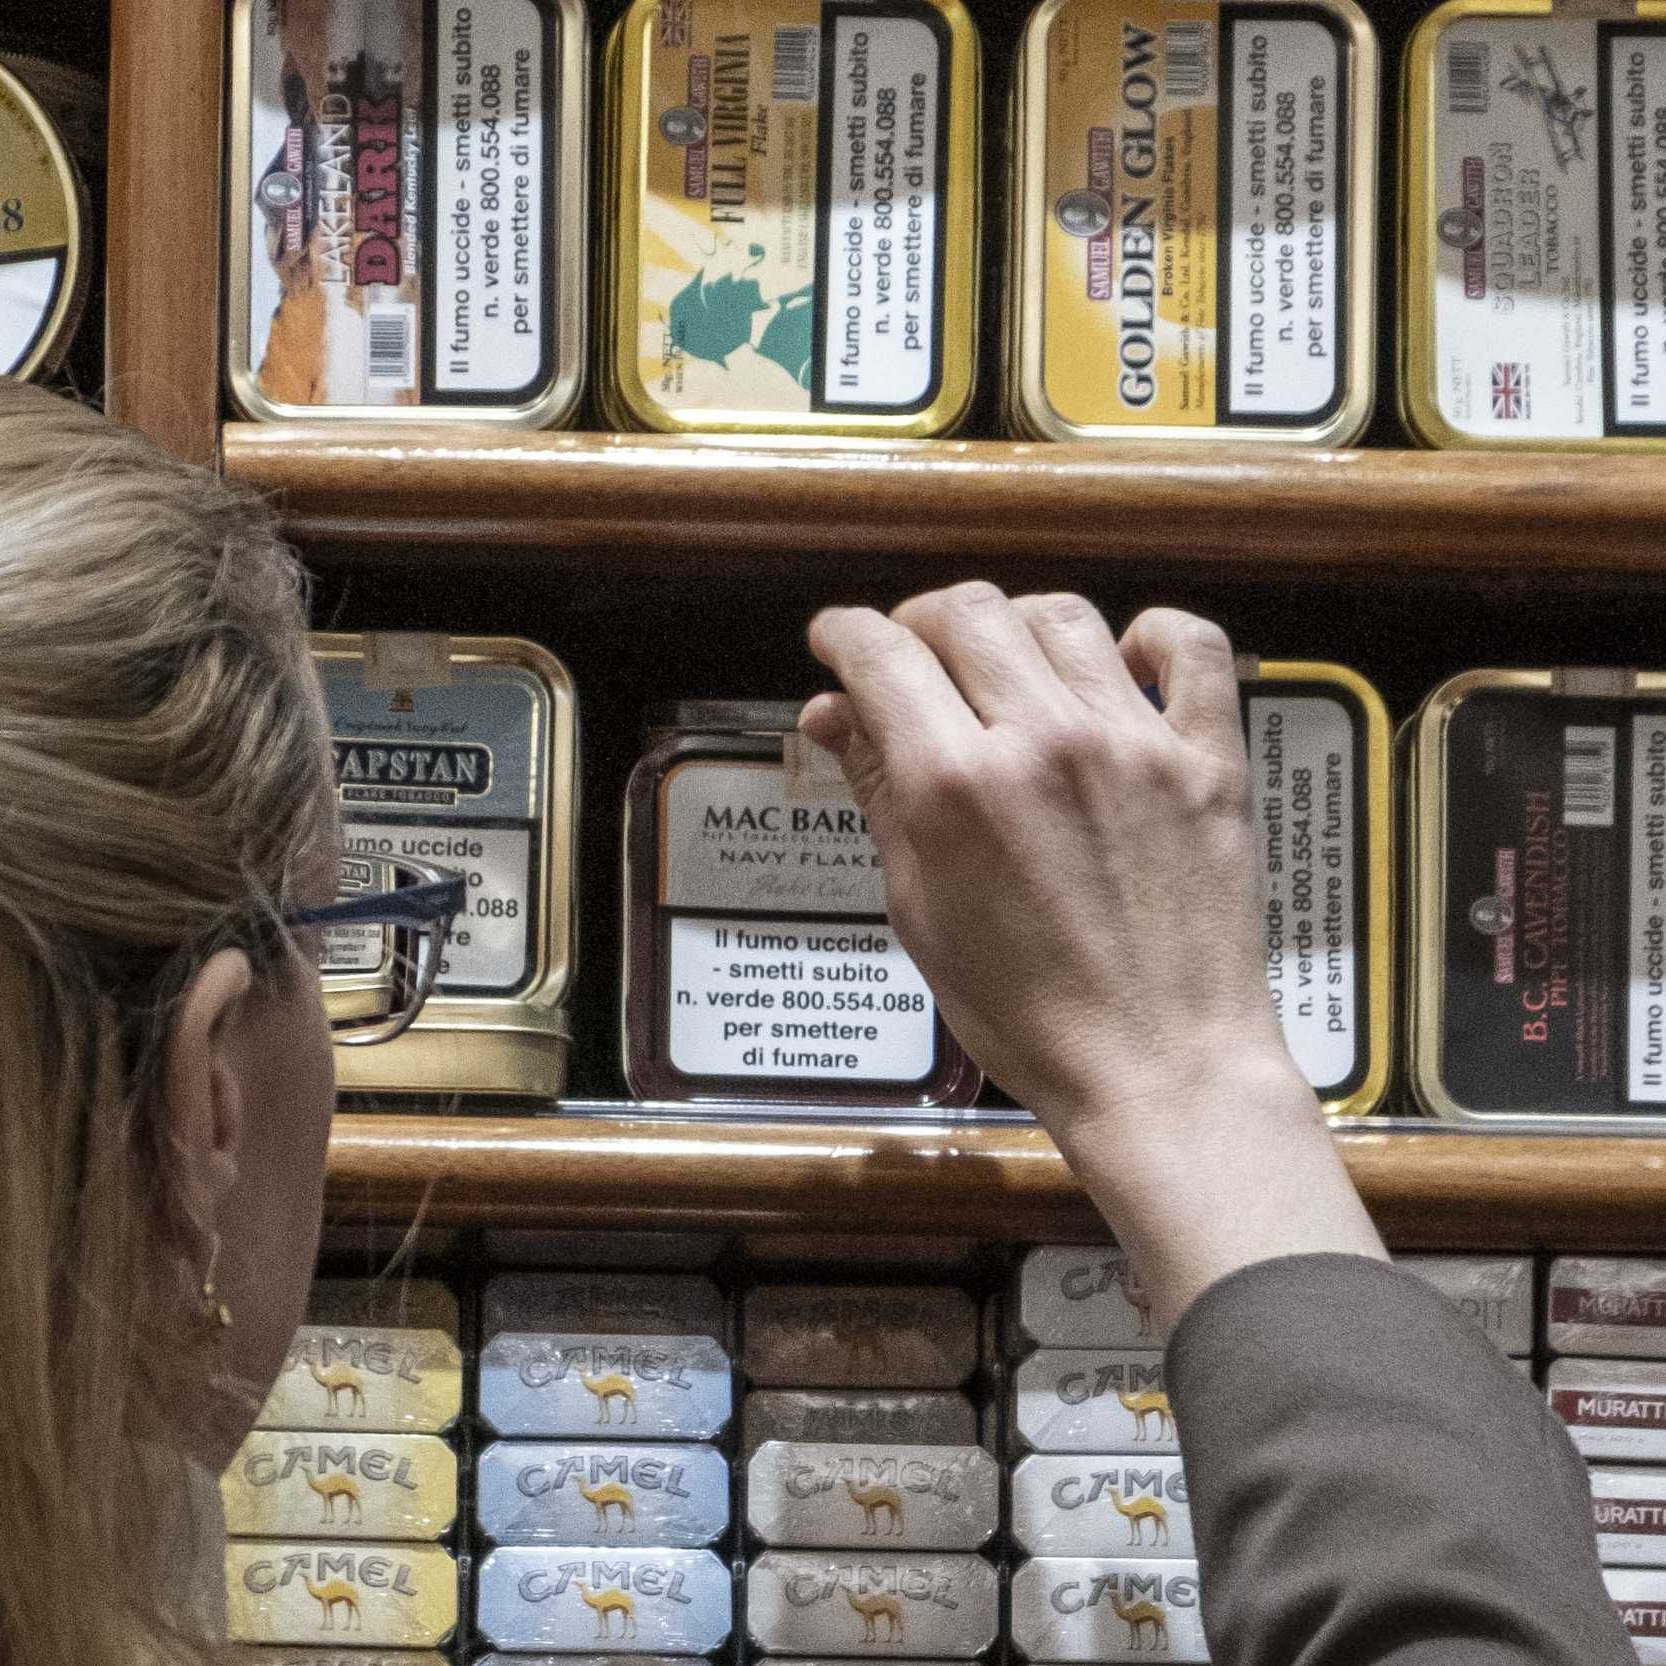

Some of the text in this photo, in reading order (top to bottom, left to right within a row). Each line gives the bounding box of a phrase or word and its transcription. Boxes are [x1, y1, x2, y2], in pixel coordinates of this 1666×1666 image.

[710, 33, 749, 222] FULL VIRGINIA
[750, 104, 768, 157] Flake
[319, 93, 351, 286] LAKELAND
[354, 94, 401, 285] DARK
[448, 5, 474, 376] Il fumo uccide smetti subito
[478, 62, 502, 320] n. verde 800.554.088
[511, 48, 532, 336] per smettere di fumare
[1118, 21, 1158, 410] GOLDEN GLOW
[1162, 135, 1175, 297] Broken Virginia Flakes
[285, 206, 303, 251] SAMUEL
[403, 216, 420, 274] Blended
[1546, 184, 1559, 273] TOBACCO
[1089, 238, 1111, 298] SAMUEL
[333, 748, 478, 783] APSTAN
[704, 805, 780, 831] MAC
[720, 850, 886, 868] NAVY FLAKE
[714, 928, 889, 955] Il fumo uccide
[1522, 790, 1551, 1045] B.C. CAVENDISH
[728, 959, 889, 985] smetti subito
[676, 987, 925, 1013] n. verde 800.554.088
[722, 1019, 880, 1043] per smettere
[741, 1046, 860, 1071] di fumare
[242, 1443, 420, 1492] CAMEL
[514, 1452, 691, 1501] CAMEL
[242, 1551, 420, 1599] CAMEL
